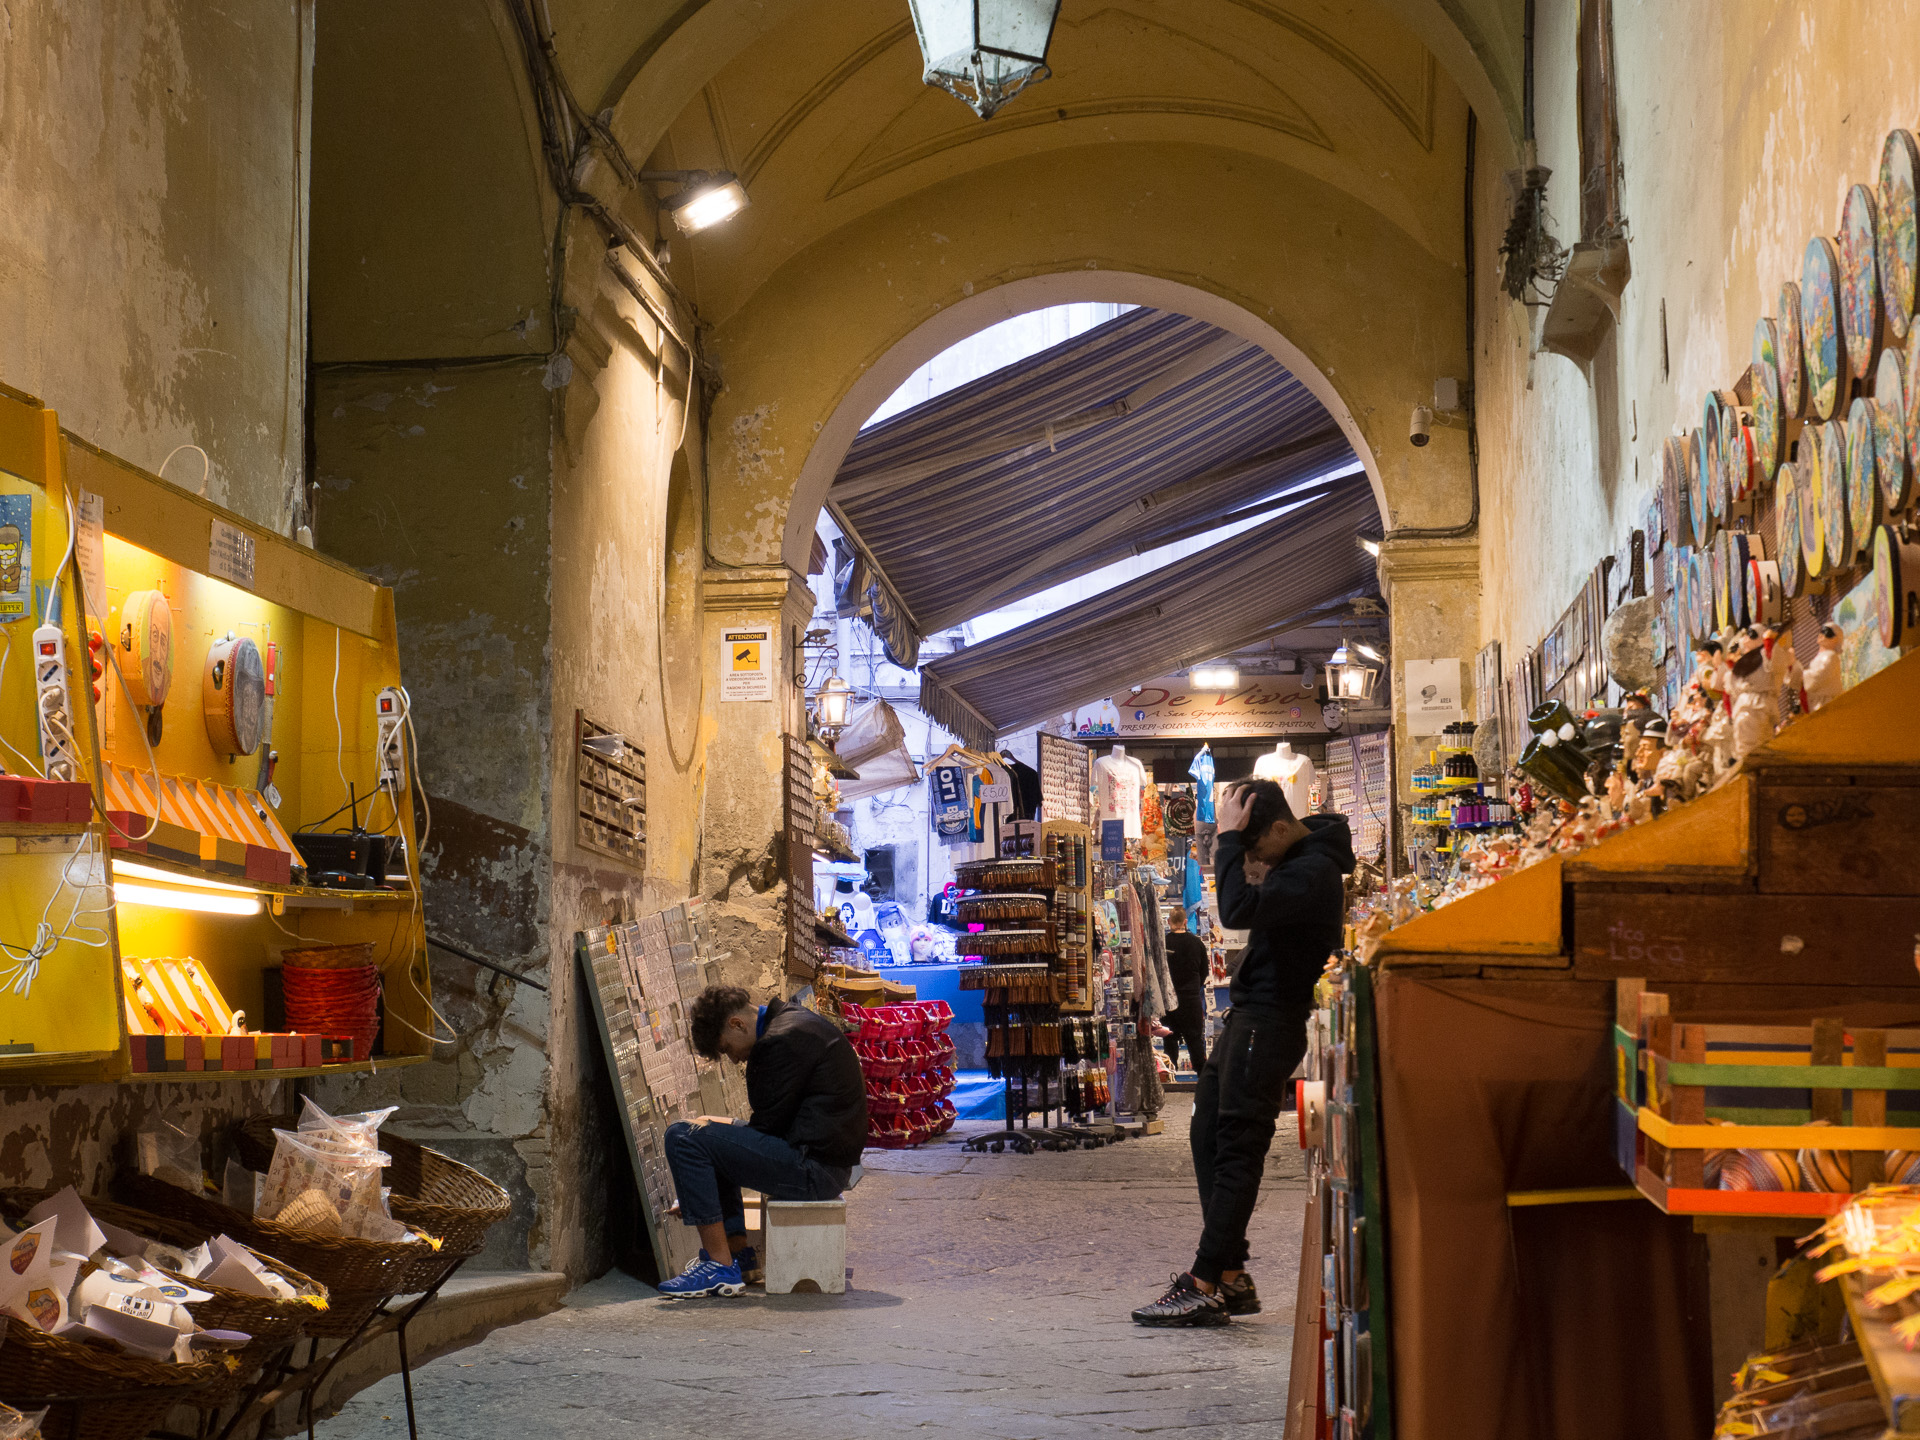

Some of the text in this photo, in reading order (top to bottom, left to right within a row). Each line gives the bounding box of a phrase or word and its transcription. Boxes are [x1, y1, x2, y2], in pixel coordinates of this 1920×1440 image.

[1120, 683, 1311, 707] De Vivo
[1191, 709, 1240, 722] Gregorio
[1242, 708, 1288, 716] Armeno
